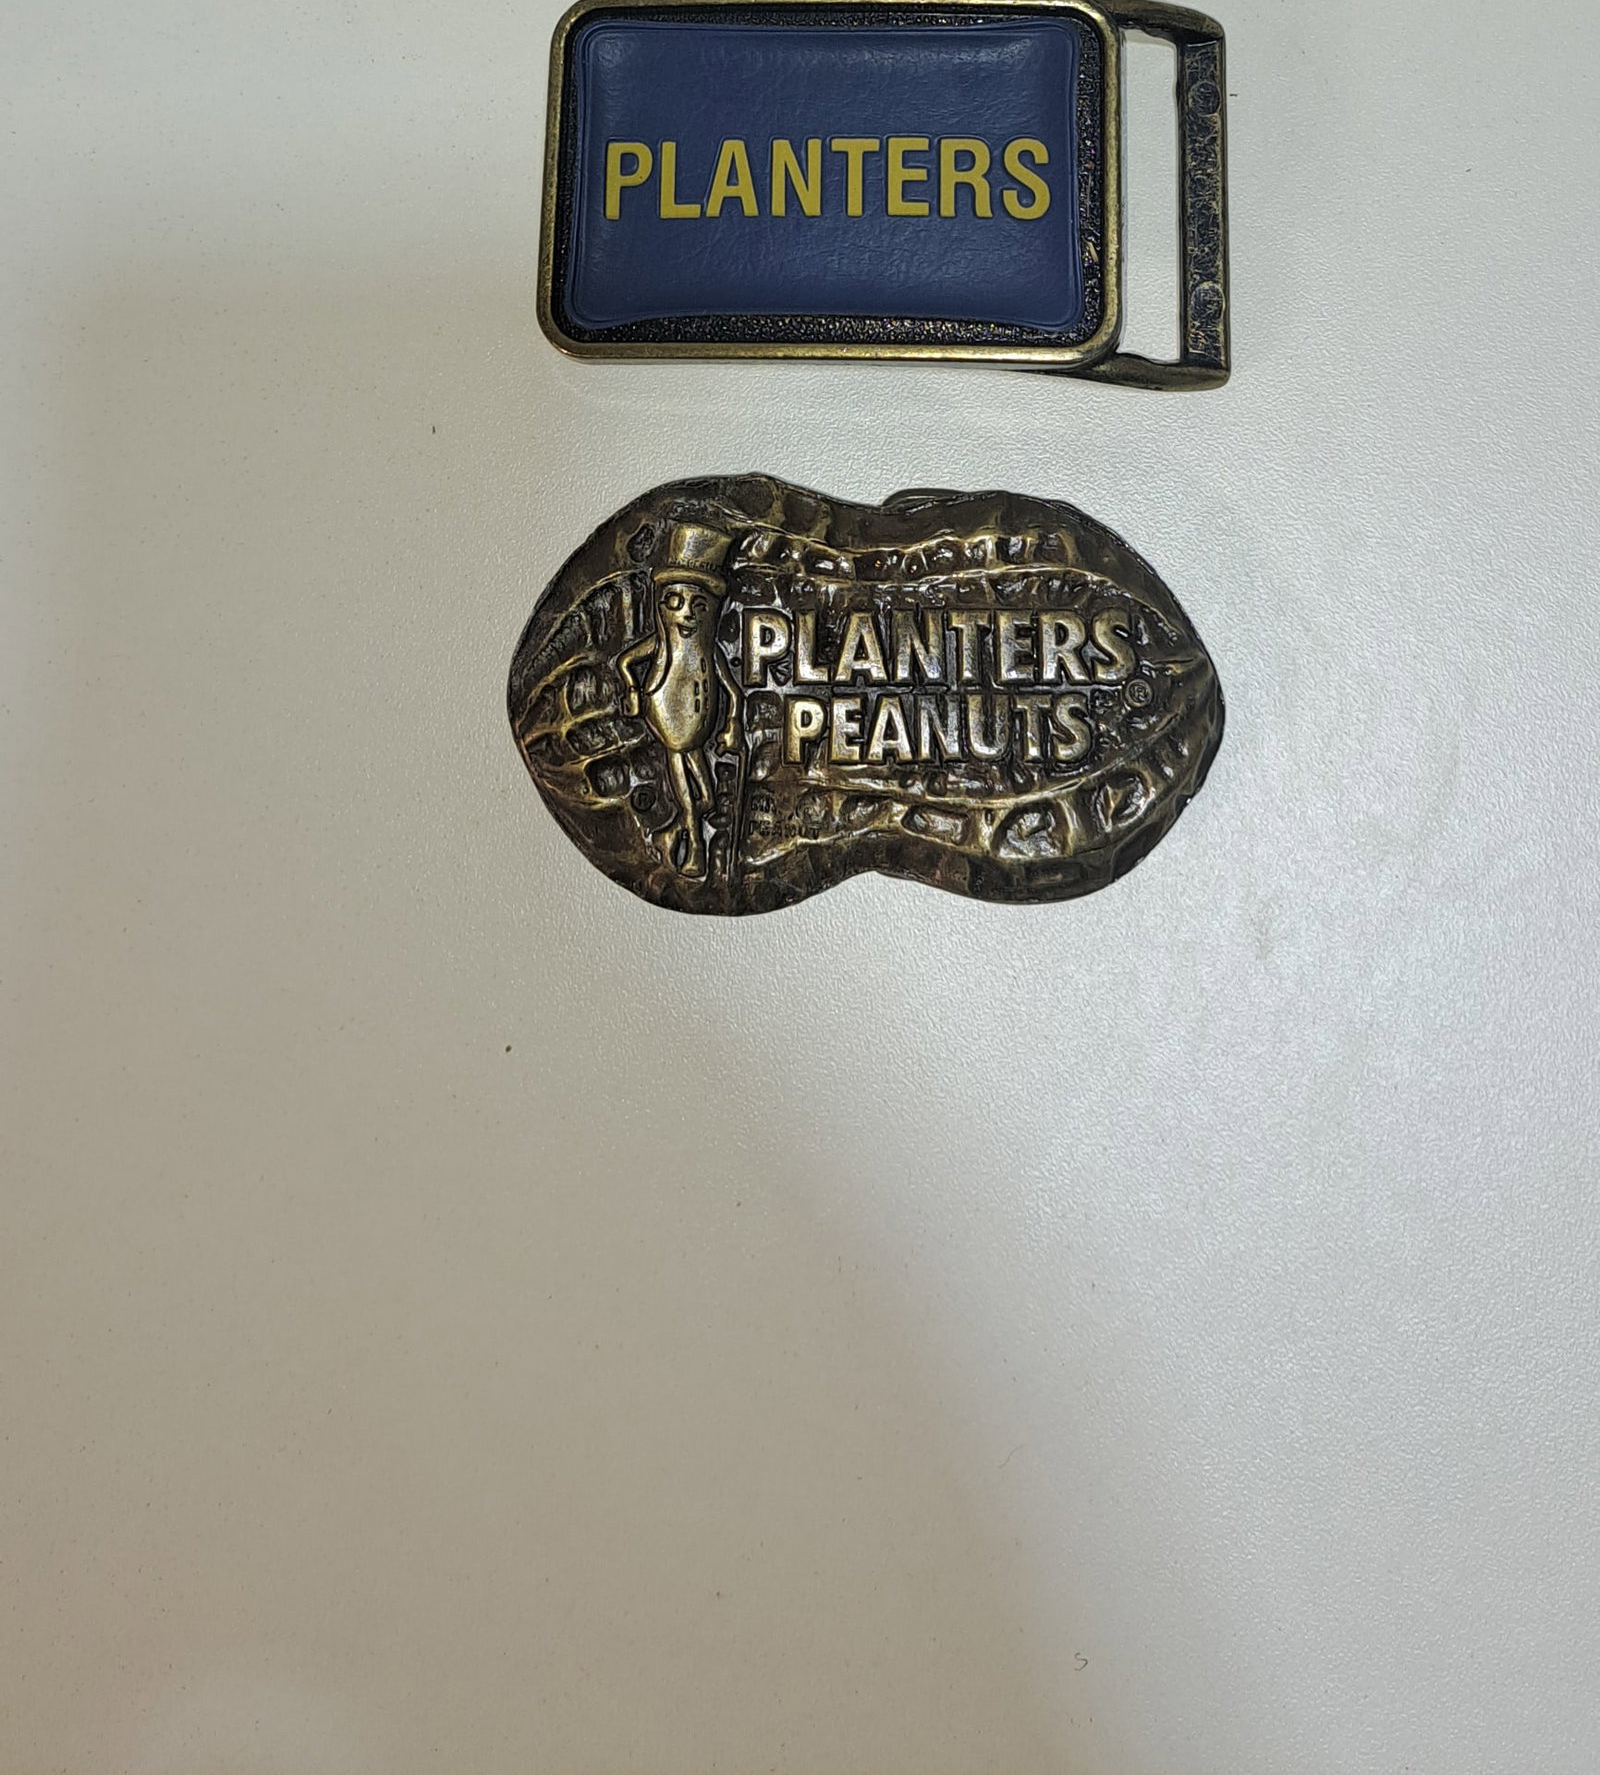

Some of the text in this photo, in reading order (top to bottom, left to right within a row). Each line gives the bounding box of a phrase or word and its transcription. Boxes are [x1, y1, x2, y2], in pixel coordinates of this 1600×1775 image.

[603, 137, 1051, 221] PLANTERS
[742, 608, 1137, 688] PLANTERS
[784, 692, 1095, 767] PEANUTS
